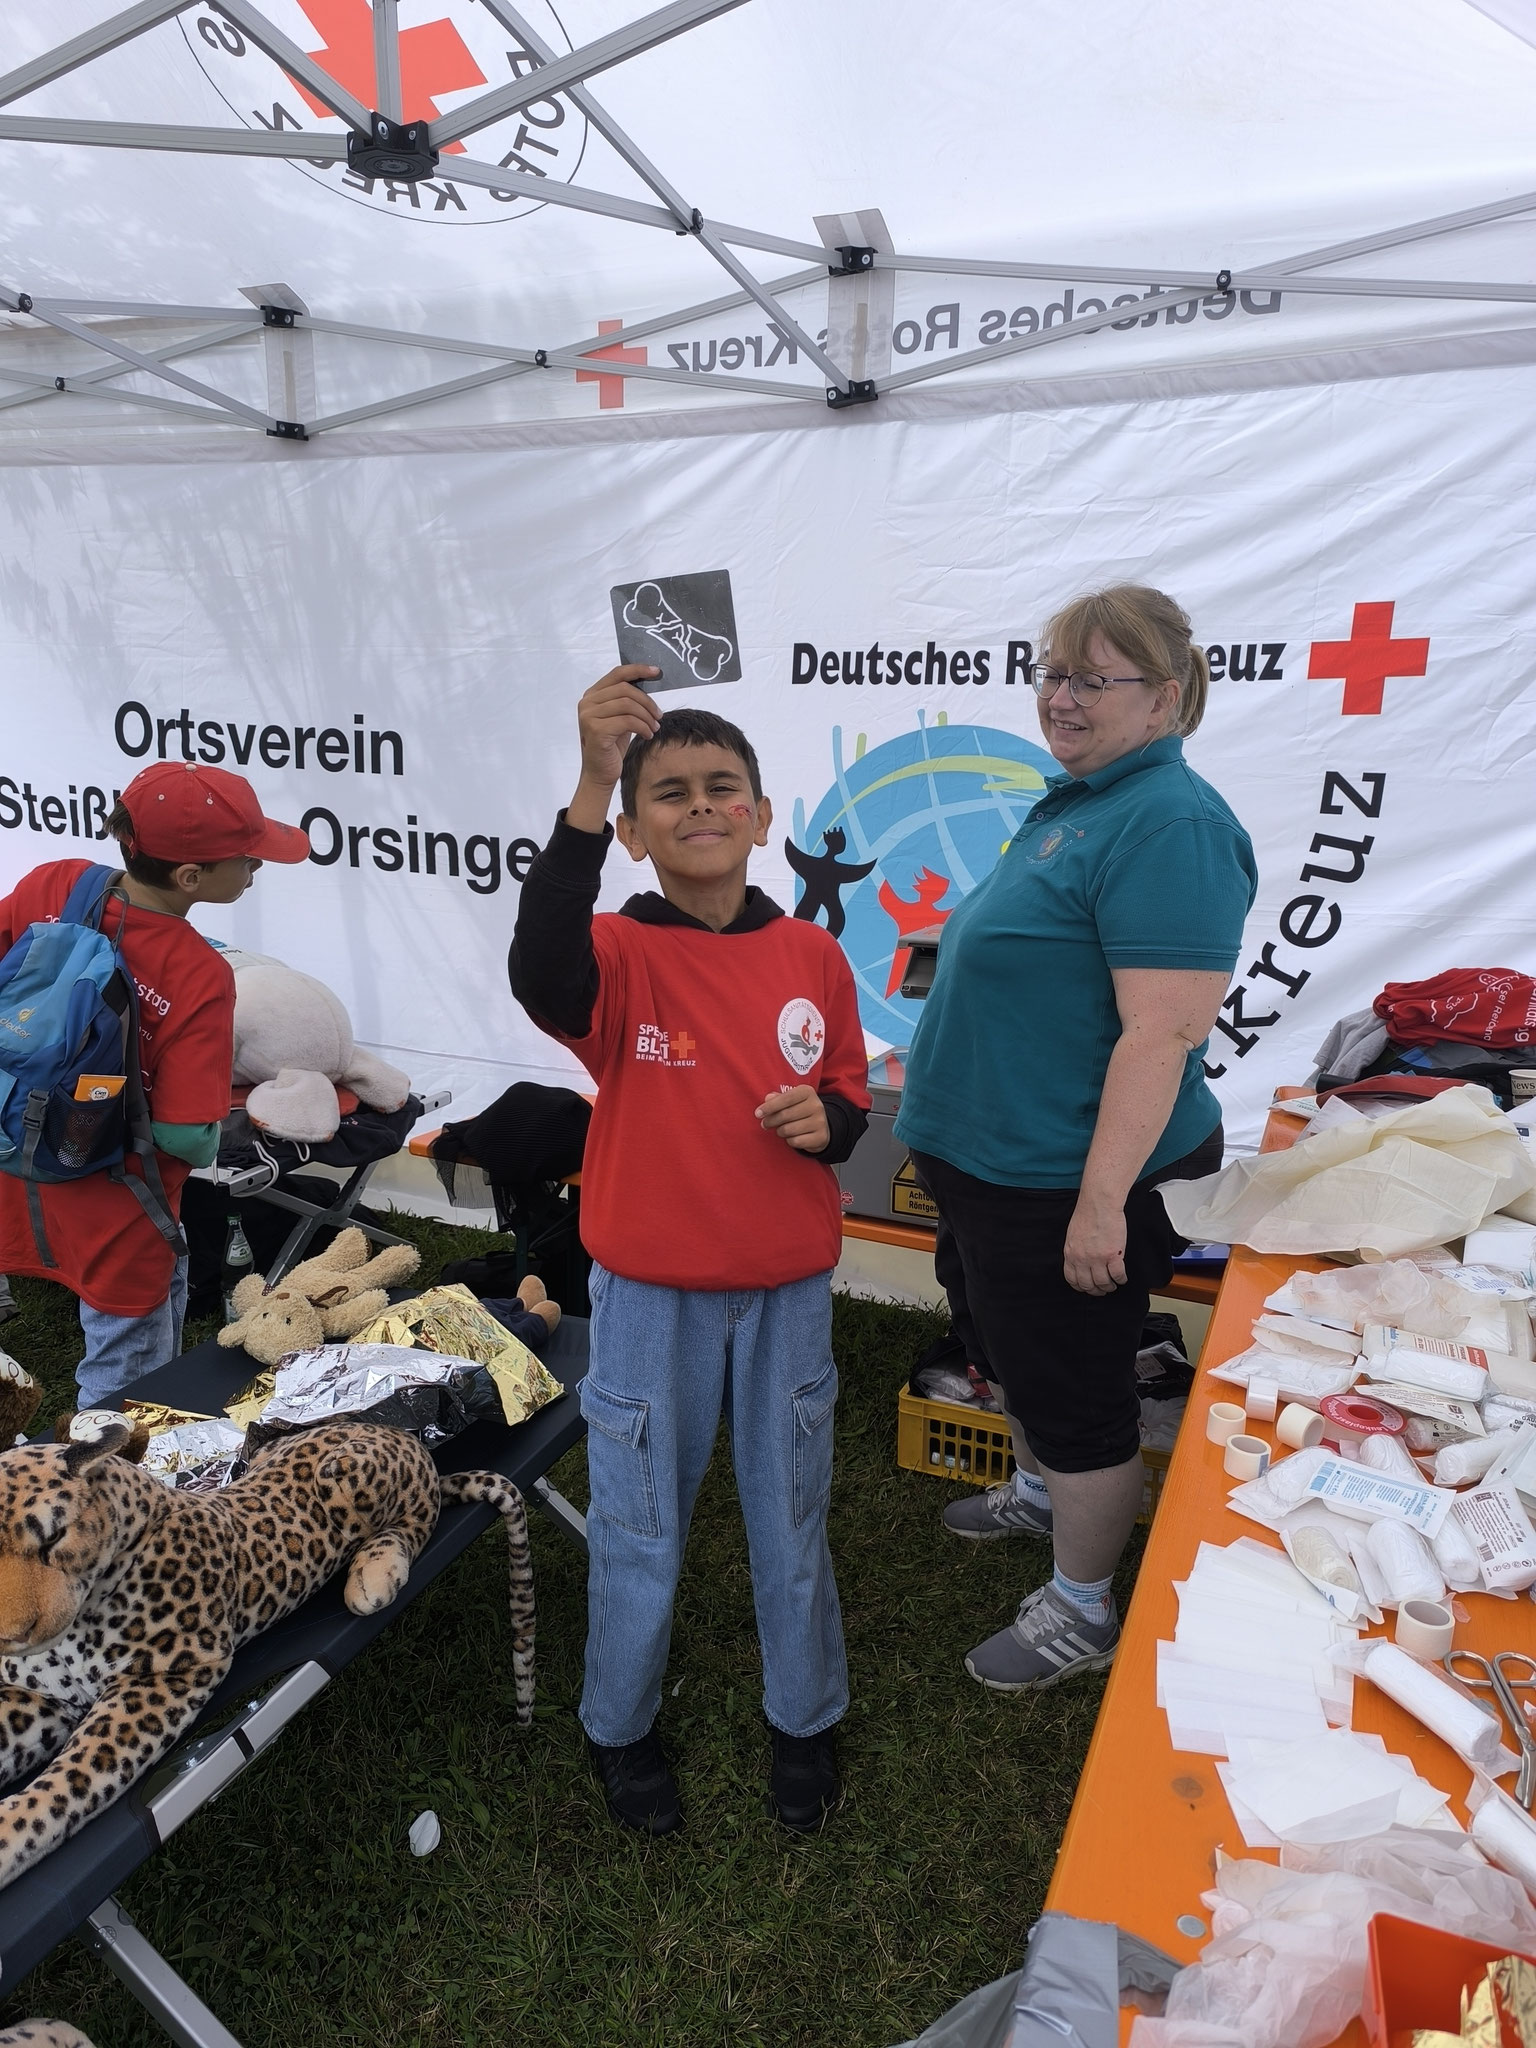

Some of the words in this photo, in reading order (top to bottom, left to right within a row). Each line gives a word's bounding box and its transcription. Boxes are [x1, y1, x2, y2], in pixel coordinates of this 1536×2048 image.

[792, 641, 991, 686] Deutsches
[1200, 642, 1288, 682] euz
[114, 700, 404, 776] Ortsverein
[0, 776, 121, 842] Steiß
[134, 977, 171, 1016] stag
